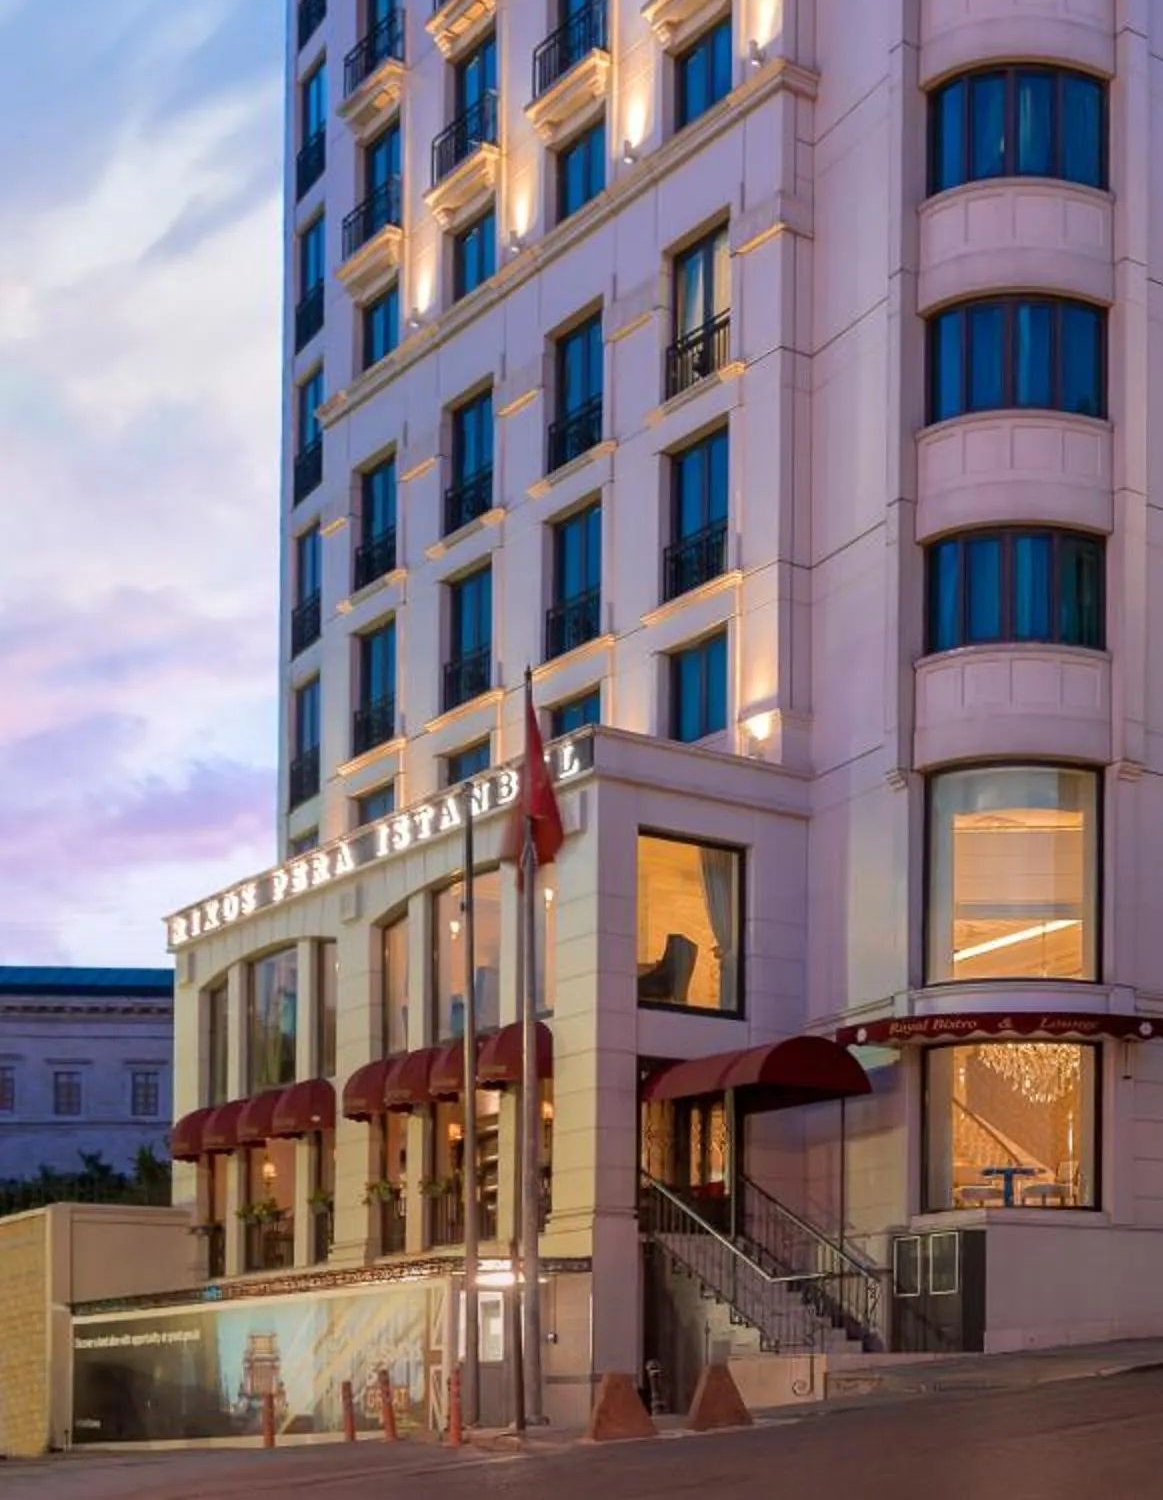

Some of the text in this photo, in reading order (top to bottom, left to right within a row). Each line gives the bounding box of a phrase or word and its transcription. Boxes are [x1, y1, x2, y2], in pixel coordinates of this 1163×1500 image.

[171, 743, 580, 945] RIXOS PERA ISTANBL
[889, 1019, 929, 1036] Royal
[932, 1017, 978, 1031] Bistro
[998, 1017, 1014, 1029] &
